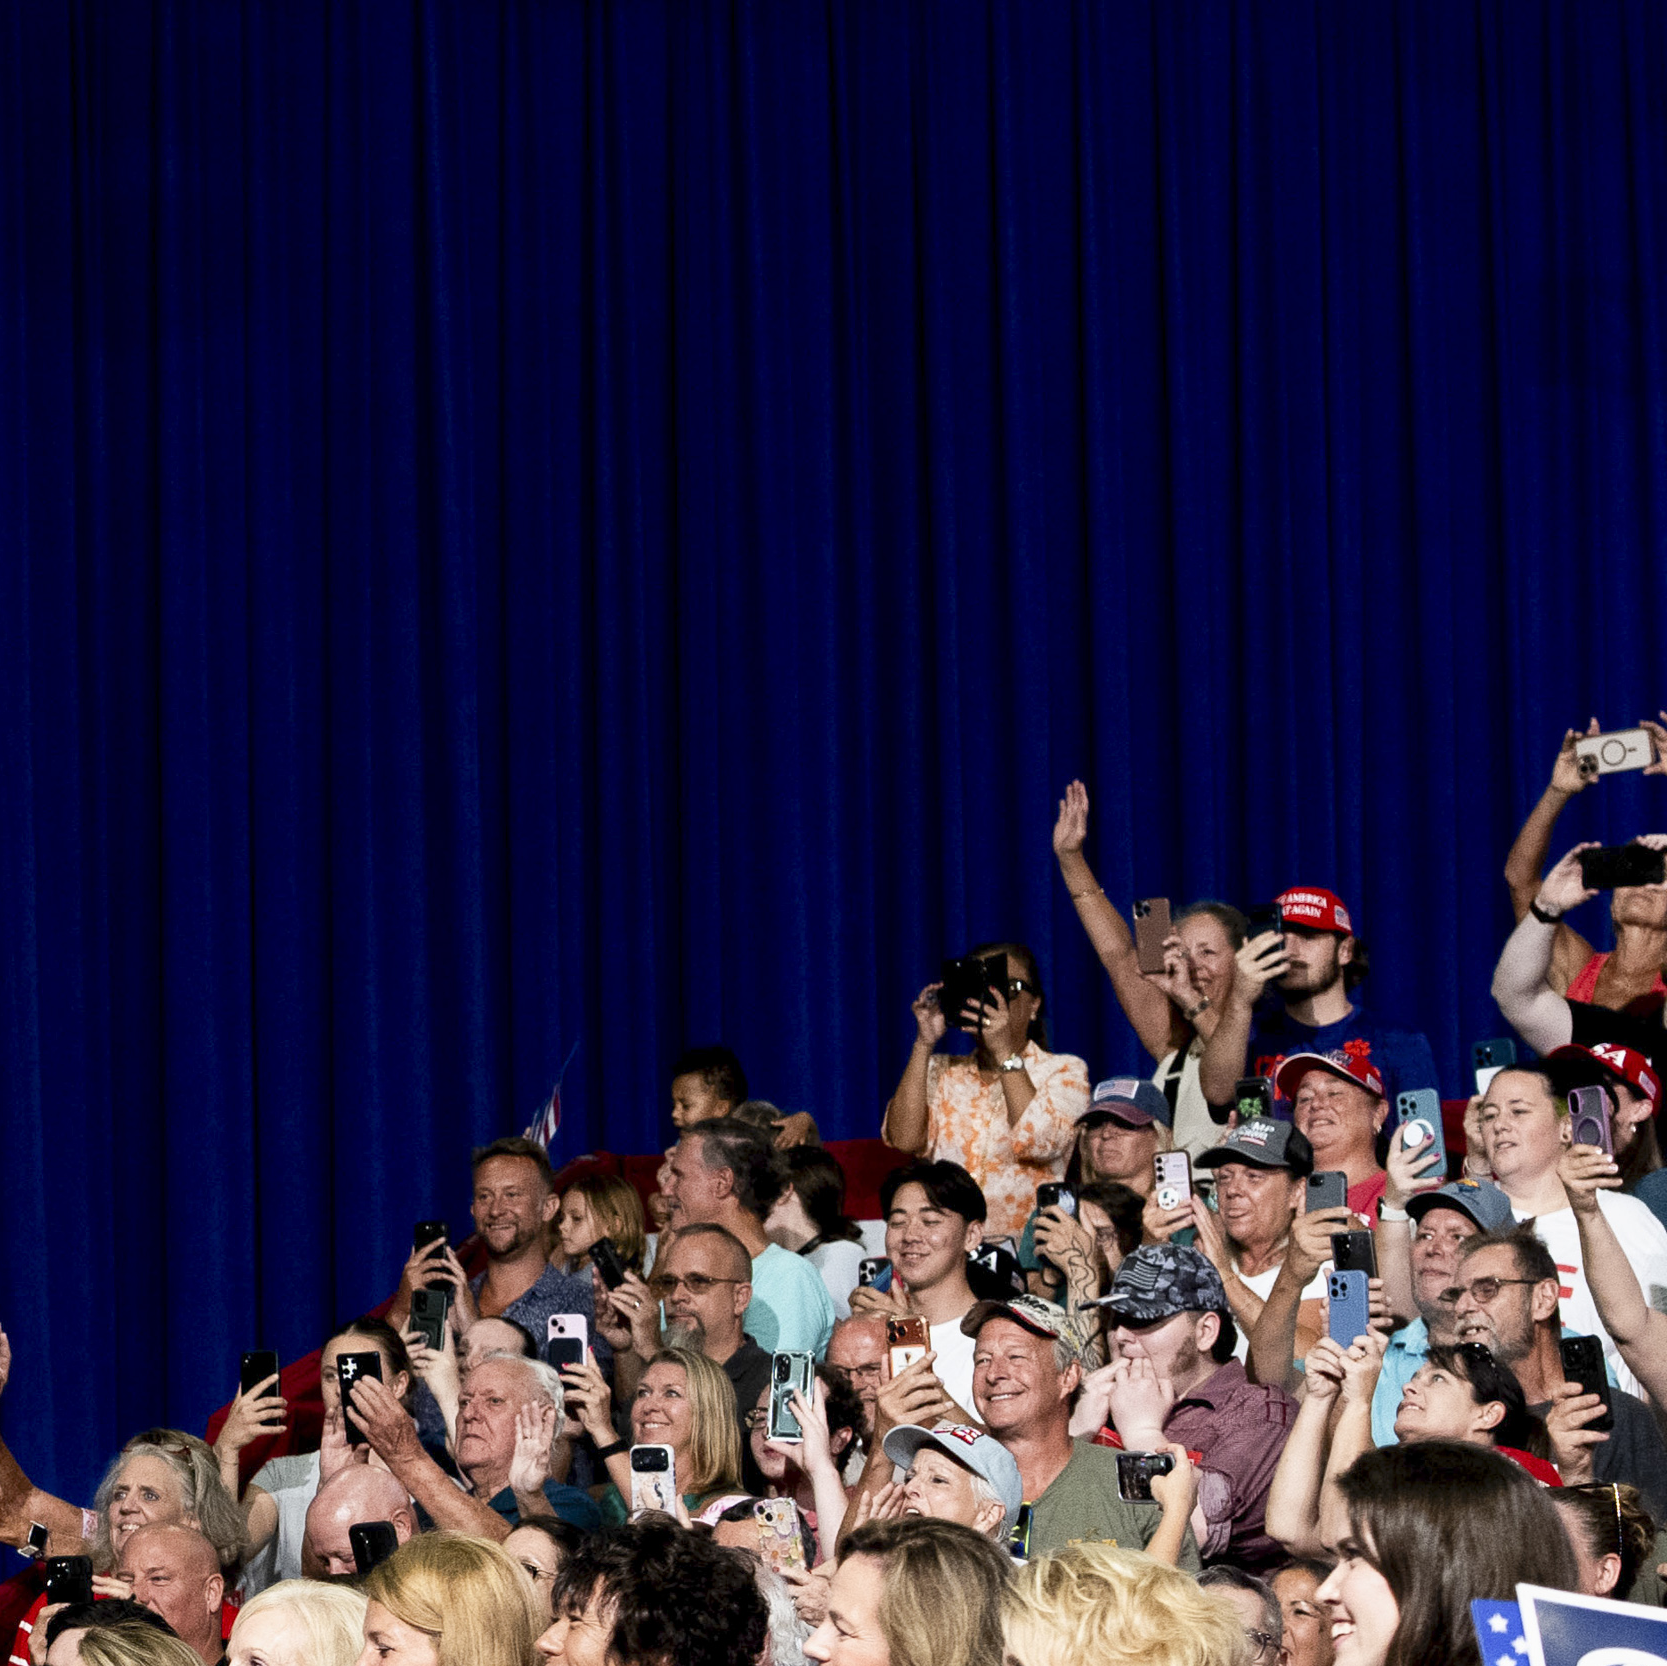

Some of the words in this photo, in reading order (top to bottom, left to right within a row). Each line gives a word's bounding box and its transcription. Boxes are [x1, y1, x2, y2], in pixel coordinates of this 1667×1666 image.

[1287, 892, 1328, 909] AMERICA
[1291, 904, 1322, 918] AGAIN
[1590, 1042, 1627, 1069] SA
